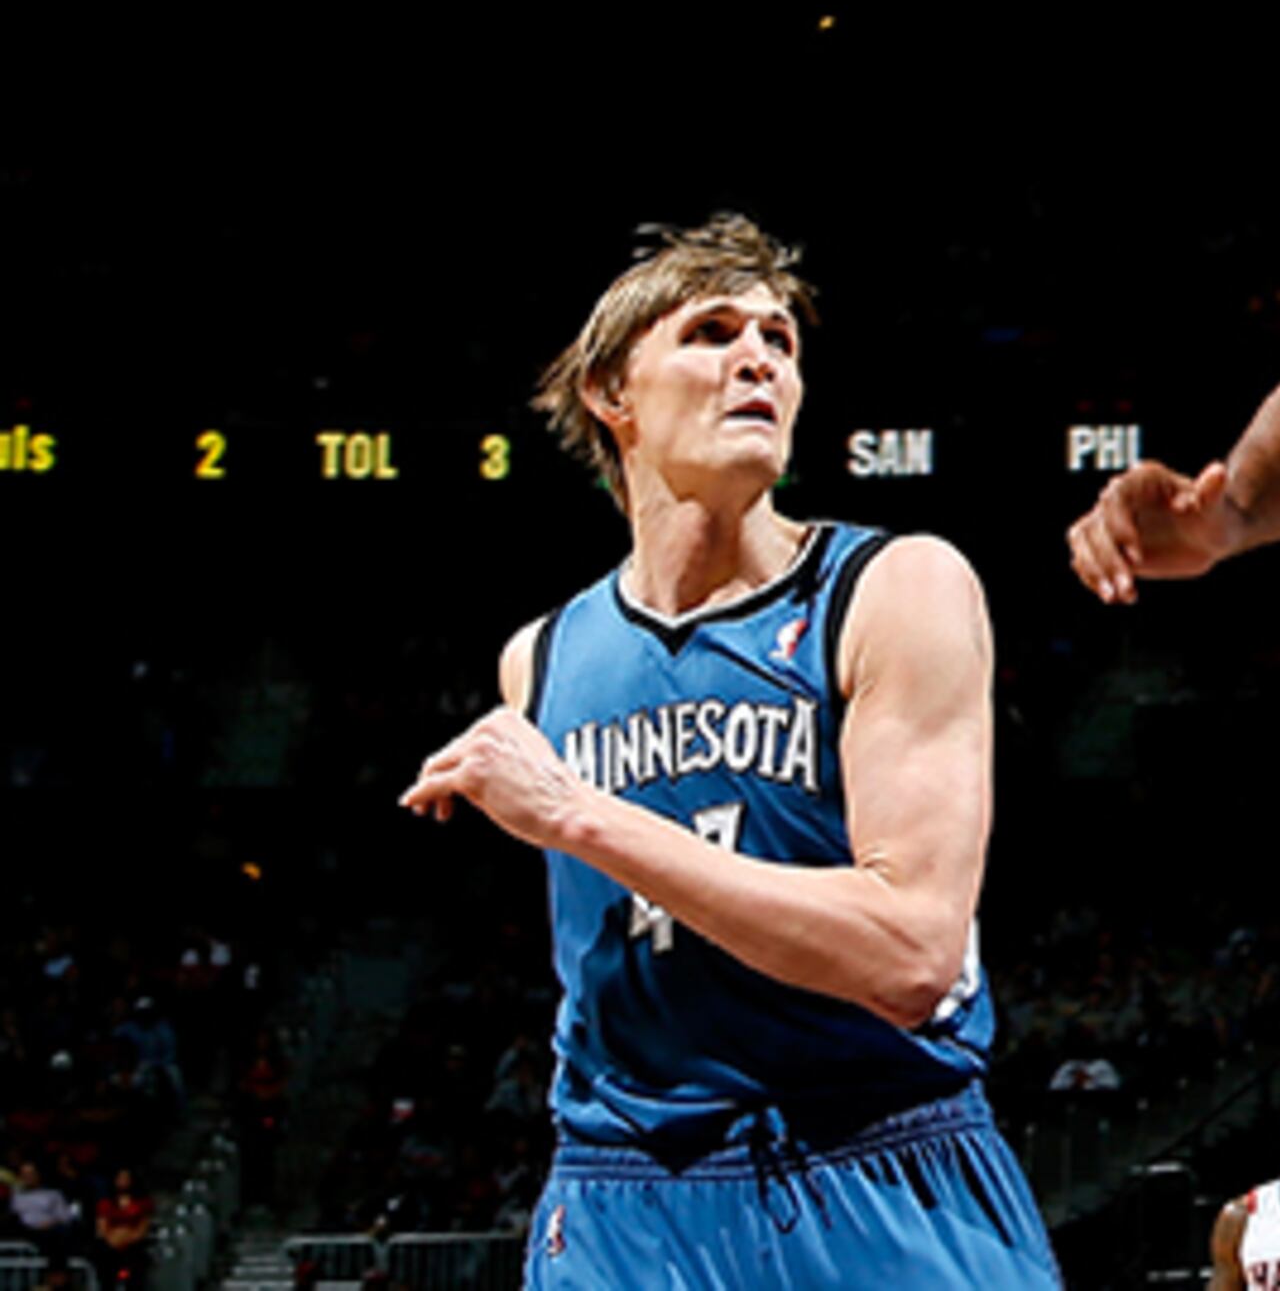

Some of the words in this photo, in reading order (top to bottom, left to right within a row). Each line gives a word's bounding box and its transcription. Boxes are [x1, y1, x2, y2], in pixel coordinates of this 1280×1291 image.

[195, 430, 226, 480] 2
[315, 431, 398, 480] TOL
[480, 433, 510, 480] 3
[847, 428, 933, 477] SAN
[1067, 424, 1141, 471] PHI
[564, 694, 820, 794] MINNESOTA
